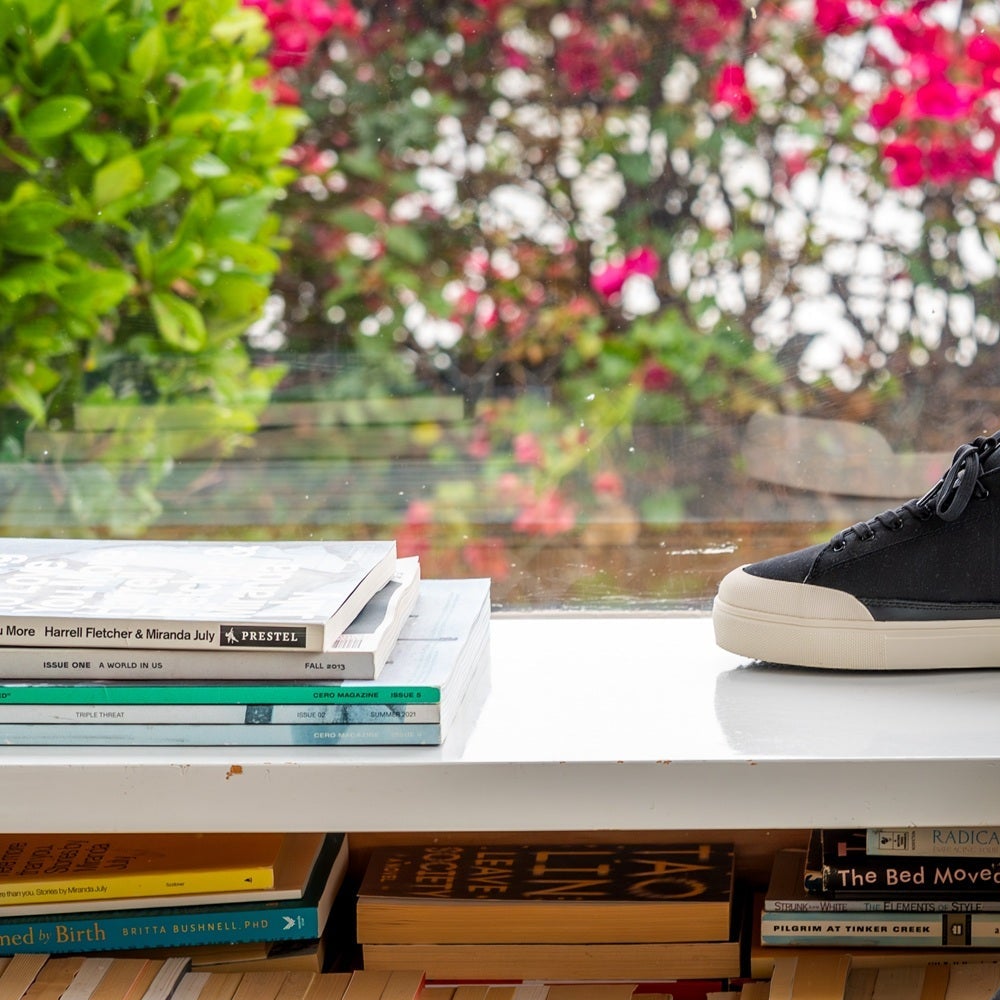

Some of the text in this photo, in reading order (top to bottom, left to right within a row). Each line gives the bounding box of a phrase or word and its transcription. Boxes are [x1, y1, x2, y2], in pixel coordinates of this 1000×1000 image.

[6, 625, 35, 636] More
[44, 625, 215, 643] Harrell Fletcher & Miranda July
[241, 631, 298, 641] PRESTEL
[75, 711, 125, 719] TRIPLE THREAT
[838, 868, 878, 886] The
[888, 866, 924, 886] Bed
[38, 922, 106, 944] by Birth
[122, 926, 168, 936] BRITTA
